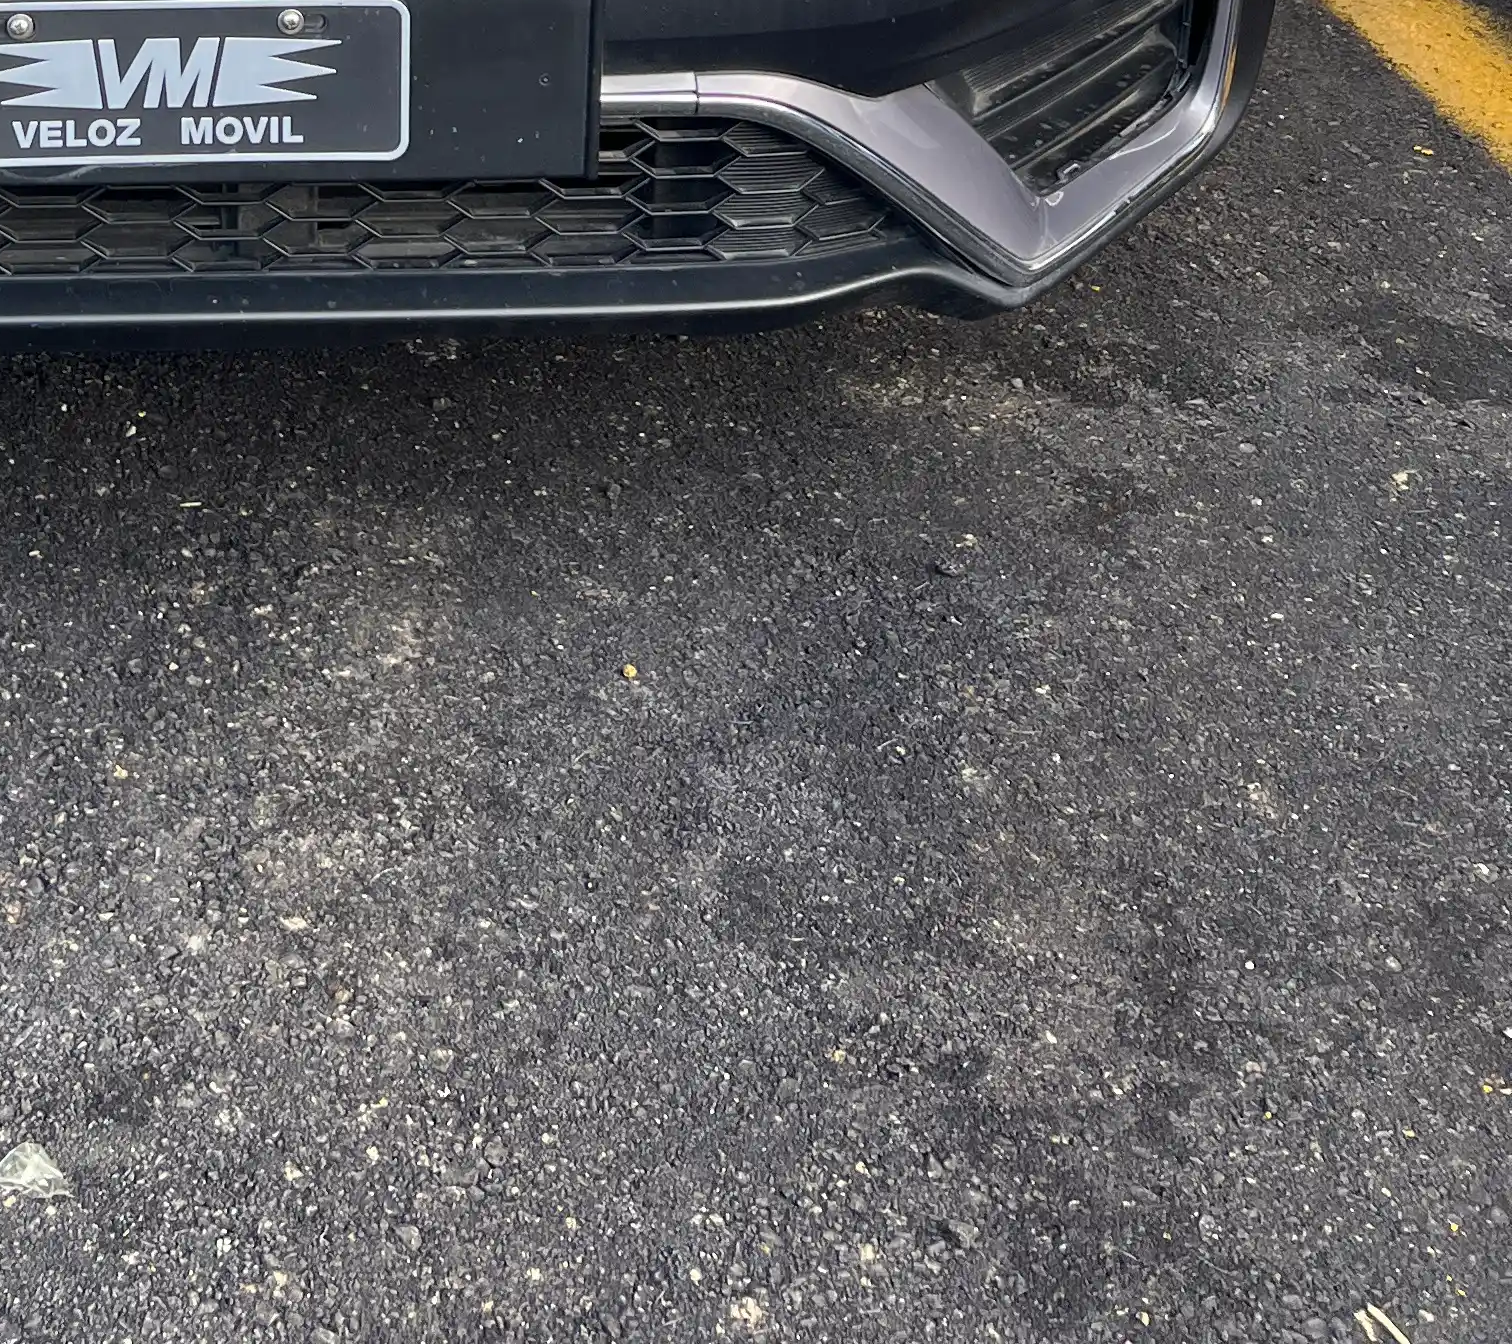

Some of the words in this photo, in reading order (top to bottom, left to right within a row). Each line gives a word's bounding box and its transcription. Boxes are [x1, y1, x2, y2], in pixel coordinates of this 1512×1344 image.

[98, 36, 220, 110] VM
[12, 118, 141, 149] VELOZ
[180, 115, 304, 145] MOVIL
